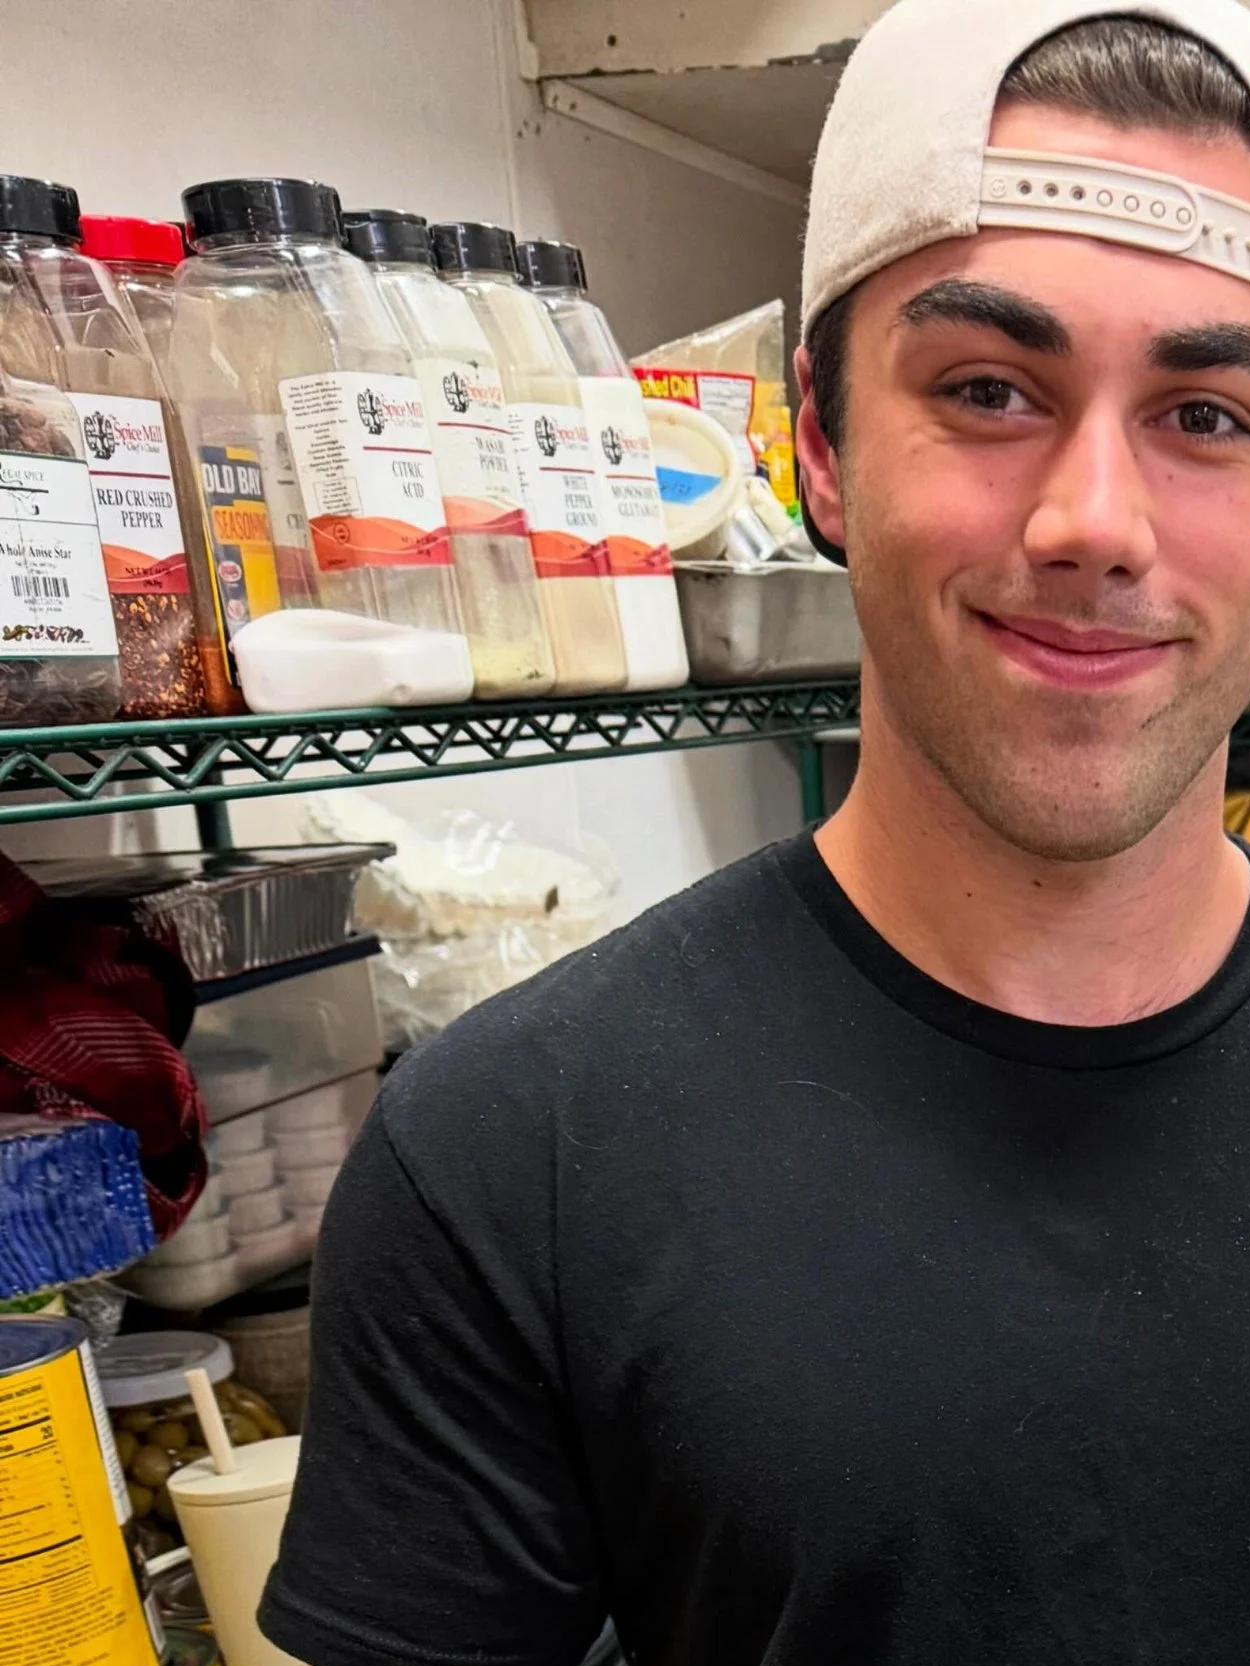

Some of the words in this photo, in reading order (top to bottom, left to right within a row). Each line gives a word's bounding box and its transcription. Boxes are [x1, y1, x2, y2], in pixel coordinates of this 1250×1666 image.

[114, 421, 142, 442] Spice
[142, 425, 163, 443] Mill
[392, 460, 425, 479] CITRIC
[204, 462, 236, 493] OLD
[238, 465, 262, 497] BAY
[96, 488, 123, 506] RED
[125, 489, 173, 509] CRUSHED
[402, 482, 425, 498] ACID
[121, 510, 164, 528] PEPPER
[29, 545, 53, 559] Anise
[54, 546, 72, 560] Star
